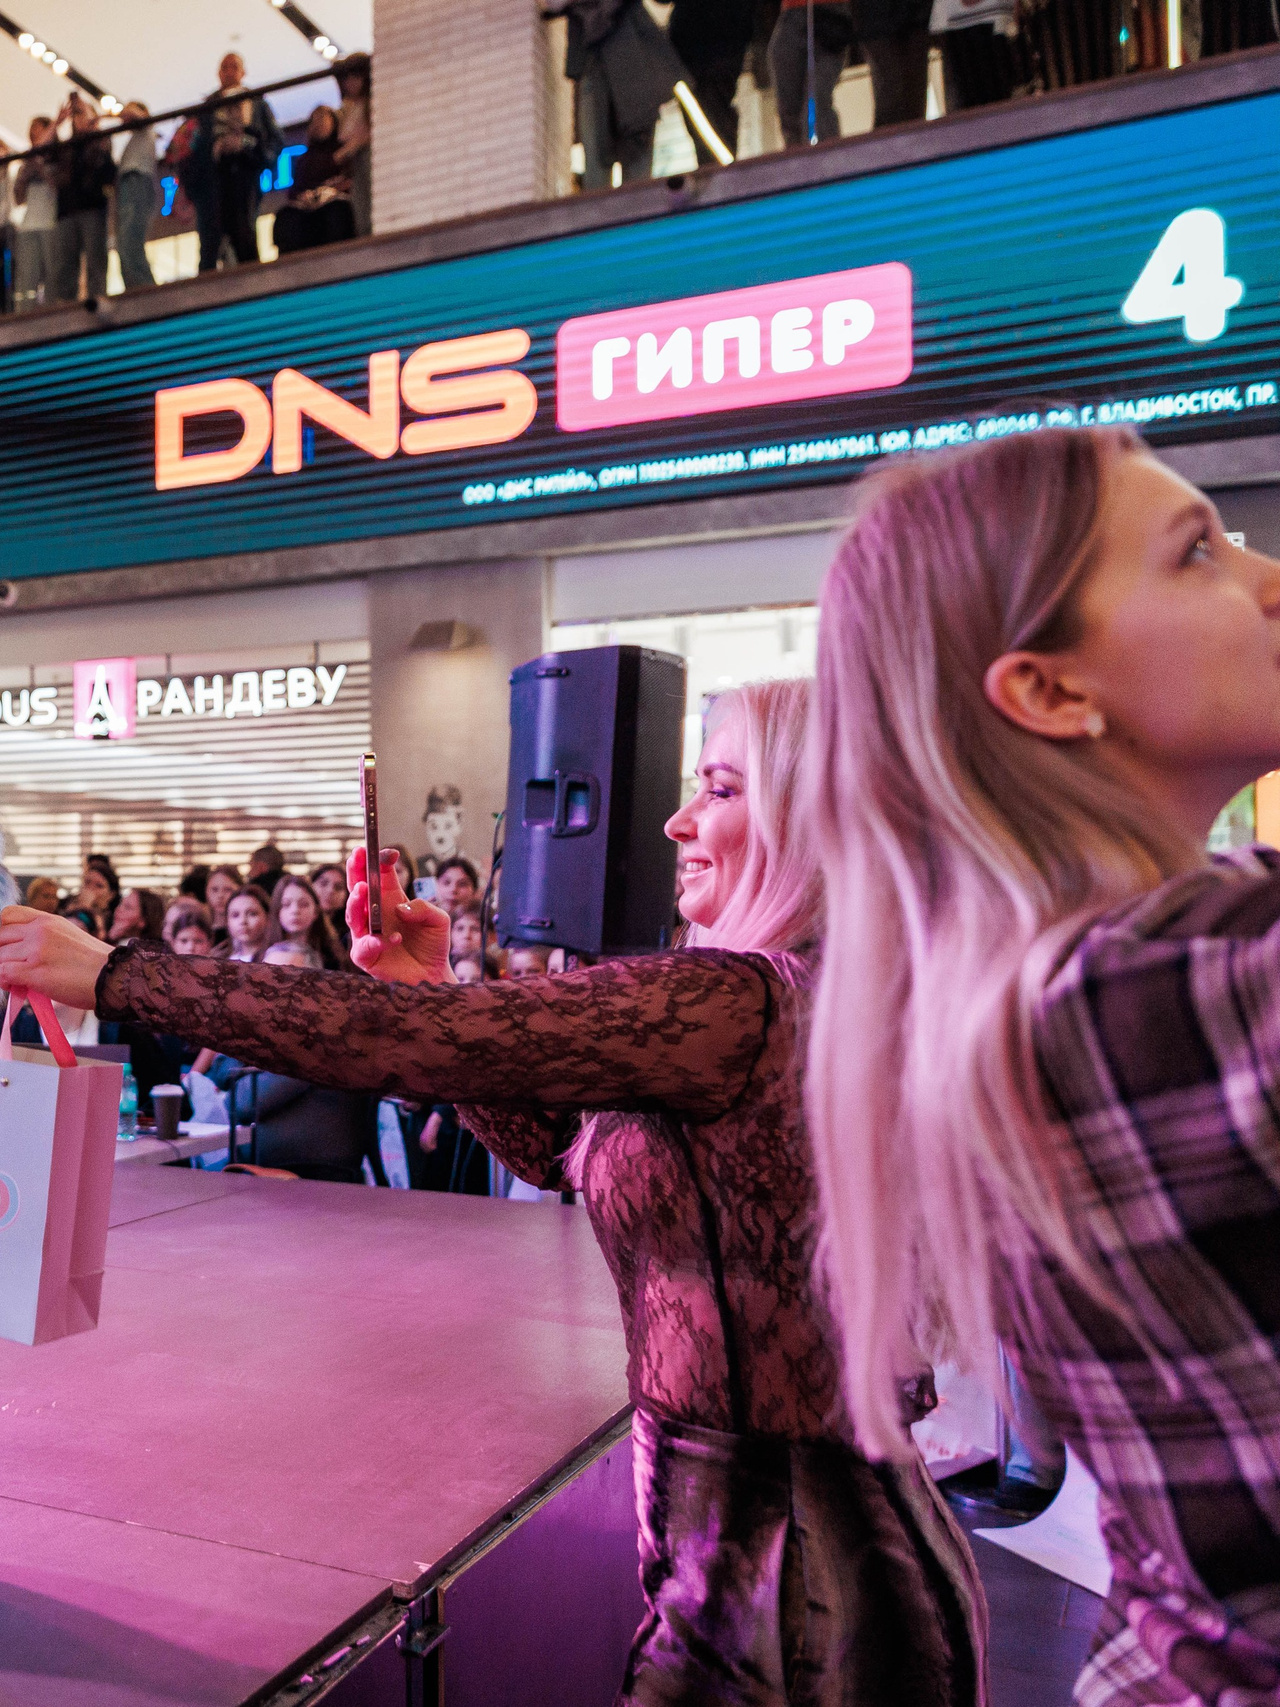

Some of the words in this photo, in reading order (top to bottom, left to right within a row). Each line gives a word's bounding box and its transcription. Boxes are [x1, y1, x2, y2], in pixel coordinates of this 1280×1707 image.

[1121, 207, 1246, 342] 4
[155, 327, 539, 491] DNS
[591, 298, 876, 401] ГИПЕР
[463, 482, 496, 505] ООО
[749, 444, 787, 471] ИНН
[1097, 385, 1245, 425] ВЛАДИВОСТОК,
[136, 664, 348, 719] РАНДЕВУ
